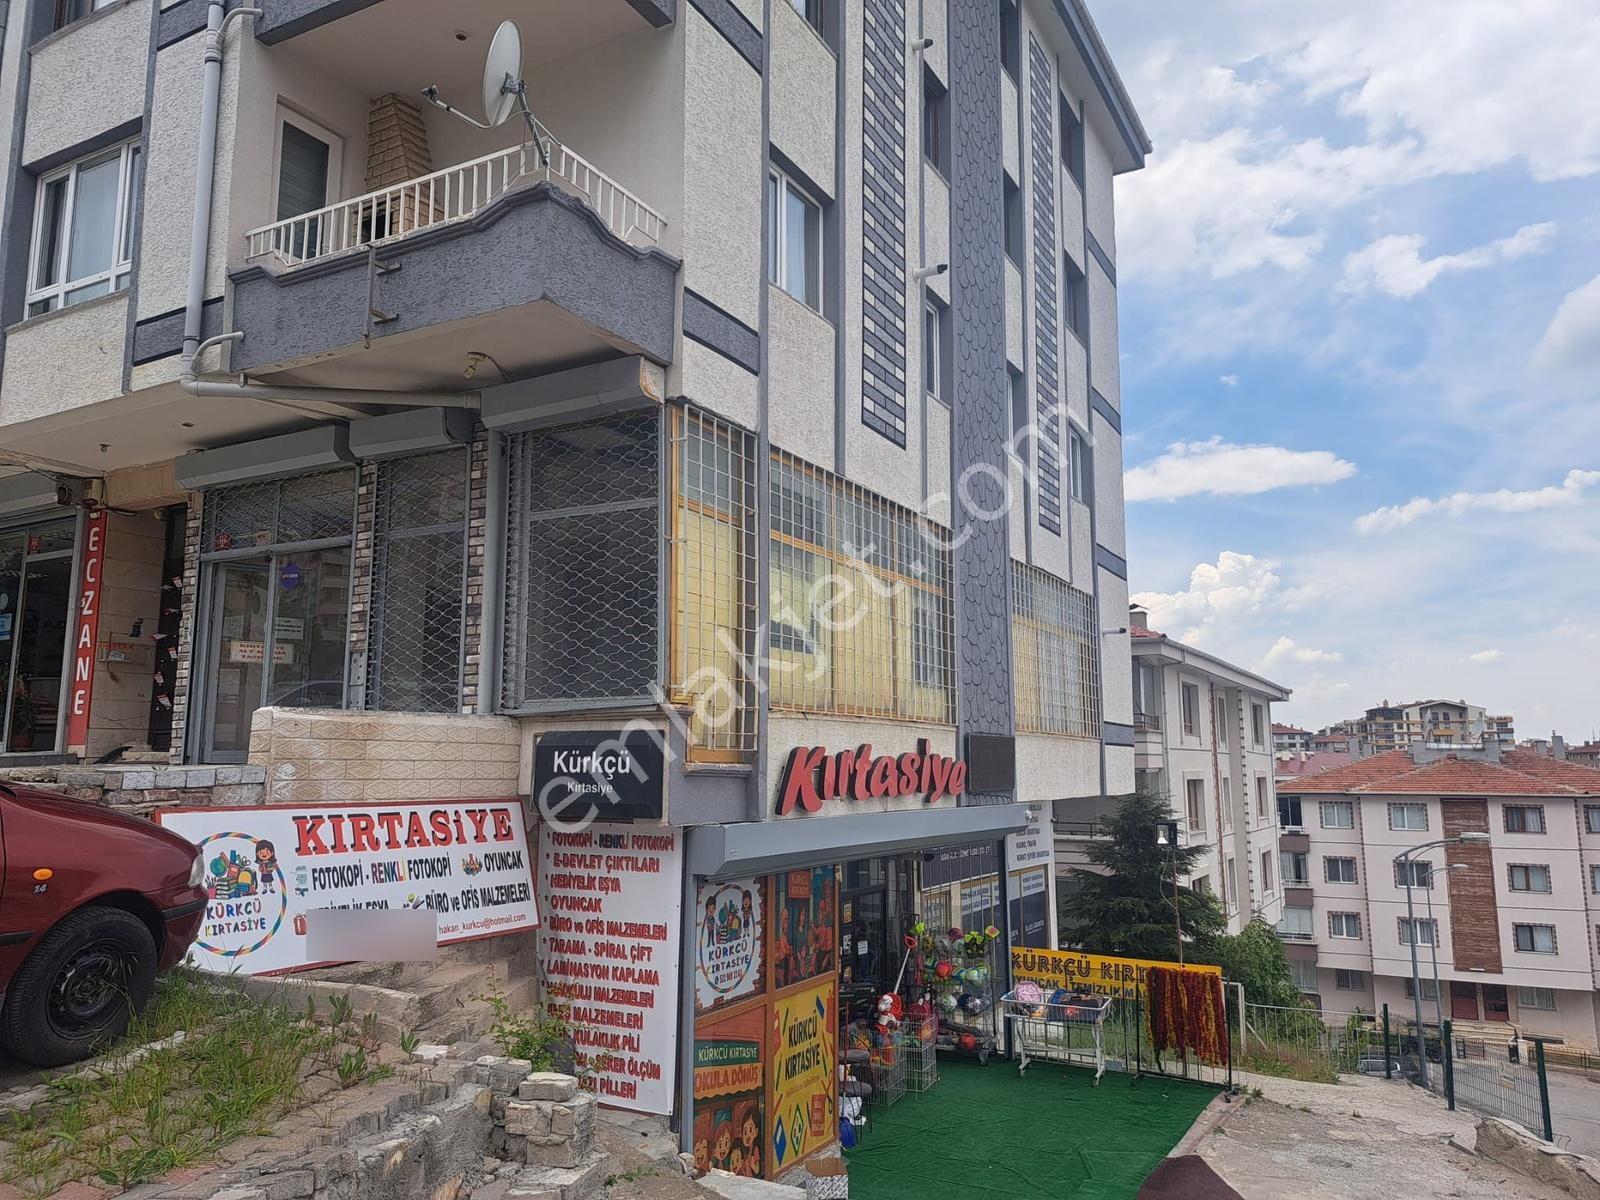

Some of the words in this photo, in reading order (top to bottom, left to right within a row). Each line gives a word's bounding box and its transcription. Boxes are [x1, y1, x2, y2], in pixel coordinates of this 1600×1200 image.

[74, 526, 100, 716] ECZANE
[553, 749, 631, 780] Kürkçü
[775, 738, 967, 816] Kırtasiye
[567, 781, 614, 796] Kırtasiye
[552, 830, 593, 845] FOTOKOPİ
[599, 831, 631, 850] RENKLİ
[632, 833, 675, 852] FOTOKOPİ
[311, 858, 364, 891] FOTOKOPİ
[371, 856, 406, 884] RENKLİ
[407, 851, 452, 881] FOTOKOPİ
[484, 850, 524, 873] OYUNCAK
[553, 852, 603, 870] E-DEVLET
[605, 855, 660, 874] ÇIKTILARI
[450, 896, 460, 911] ve
[461, 884, 480, 911] OFİS
[480, 877, 531, 908] MALZEMELERİ
[550, 871, 597, 891] HEDİYELİK
[598, 876, 621, 895] EŞYA
[550, 894, 603, 913] OYUNCAK
[205, 917, 266, 937] KIRTASİYE
[549, 914, 572, 934] BÜRO
[574, 921, 584, 934] ve
[585, 917, 604, 936] OFİS
[606, 921, 668, 941] MALZEMELERİ
[549, 937, 587, 956] TARAMA
[594, 940, 627, 960] SPİRAL
[630, 943, 653, 964] ÇİFT
[546, 958, 609, 981] LAMİNASYON
[611, 965, 660, 986] KAPLAMA
[593, 985, 655, 1009] MALZEMELERİ
[573, 1005, 644, 1030] MALZEMELERİ
[622, 1032, 641, 1053] PİLİ
[600, 1075, 637, 1100] PİLLERİ
[695, 1069, 730, 1094] OKULA
